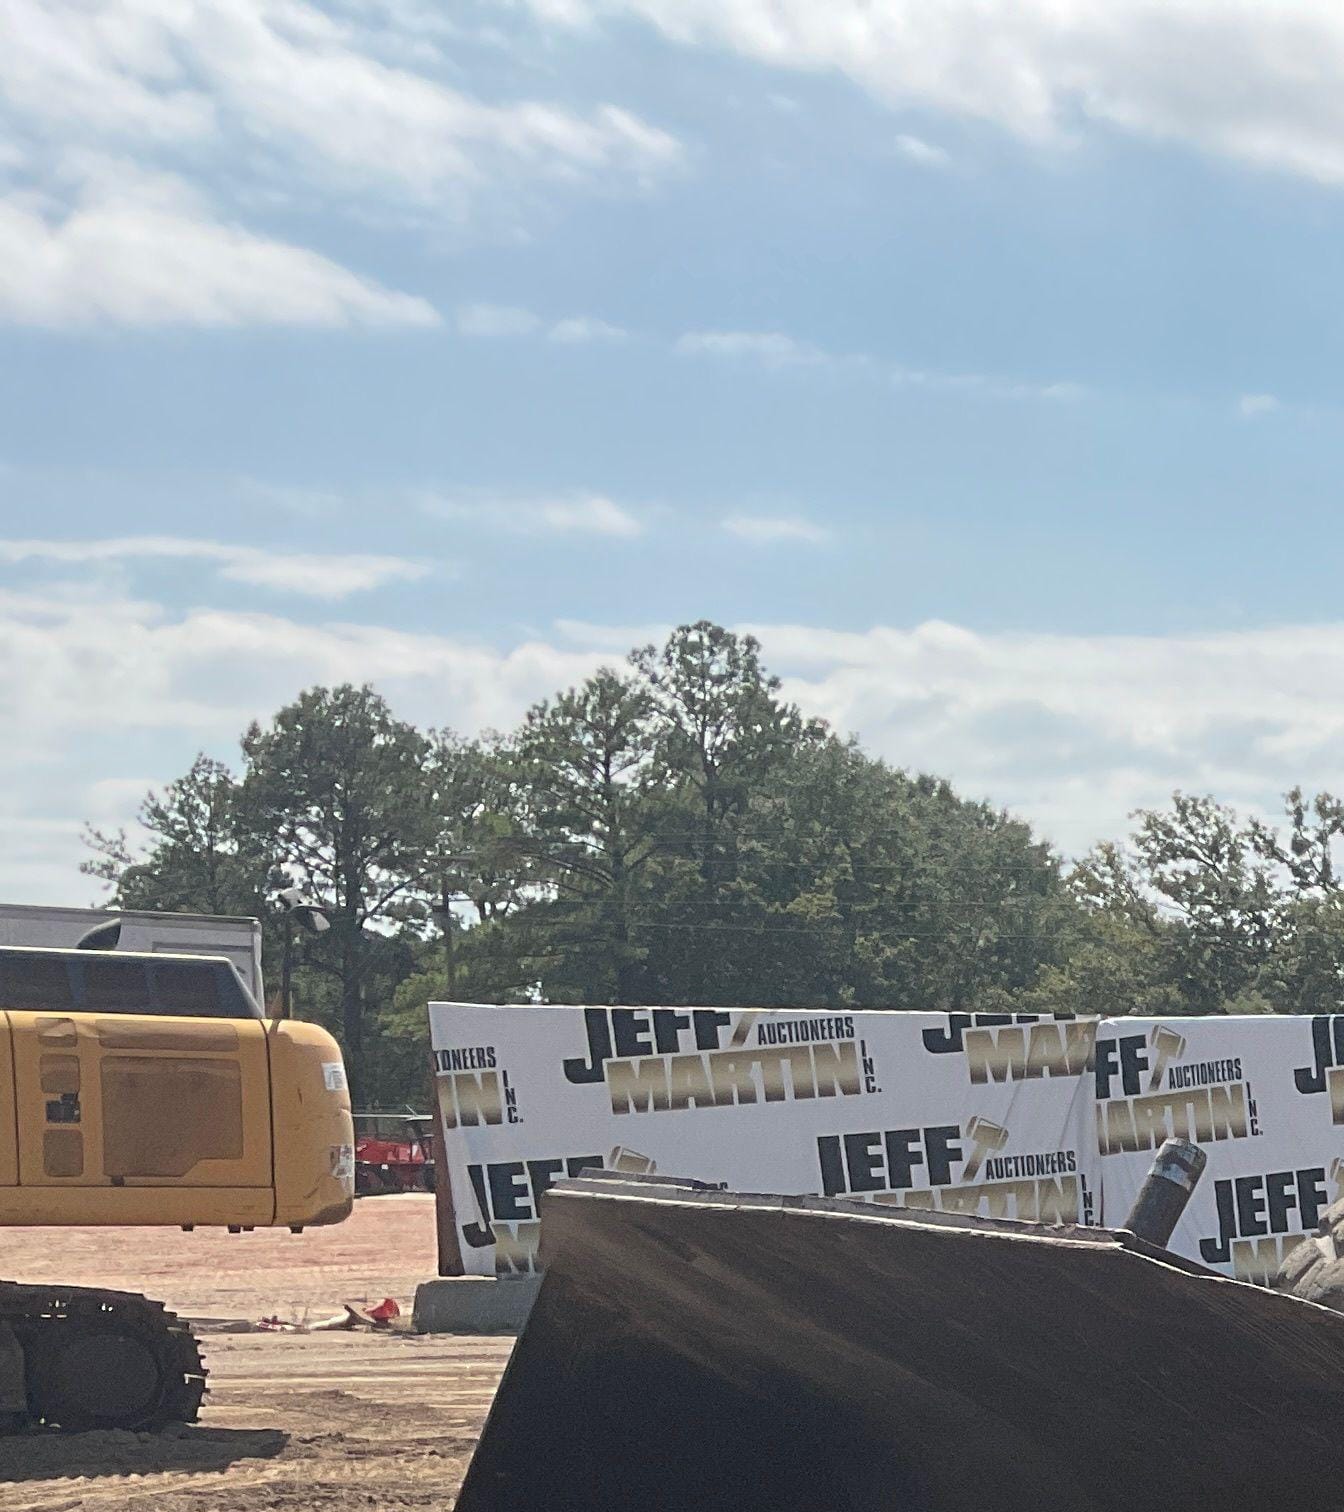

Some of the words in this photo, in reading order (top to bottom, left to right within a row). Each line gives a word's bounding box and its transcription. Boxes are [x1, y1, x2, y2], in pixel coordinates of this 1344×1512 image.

[563, 1009, 730, 1084] JEFF
[758, 1016, 855, 1046] AUCTIONEERS
[607, 1042, 861, 1115] MARTIN
[1168, 1057, 1243, 1090] AUCTIONEERS
[1096, 1084, 1248, 1157] ARTIN
[985, 1150, 1077, 1180] AUCTIONEERS
[1199, 1168, 1328, 1264] JEFF
